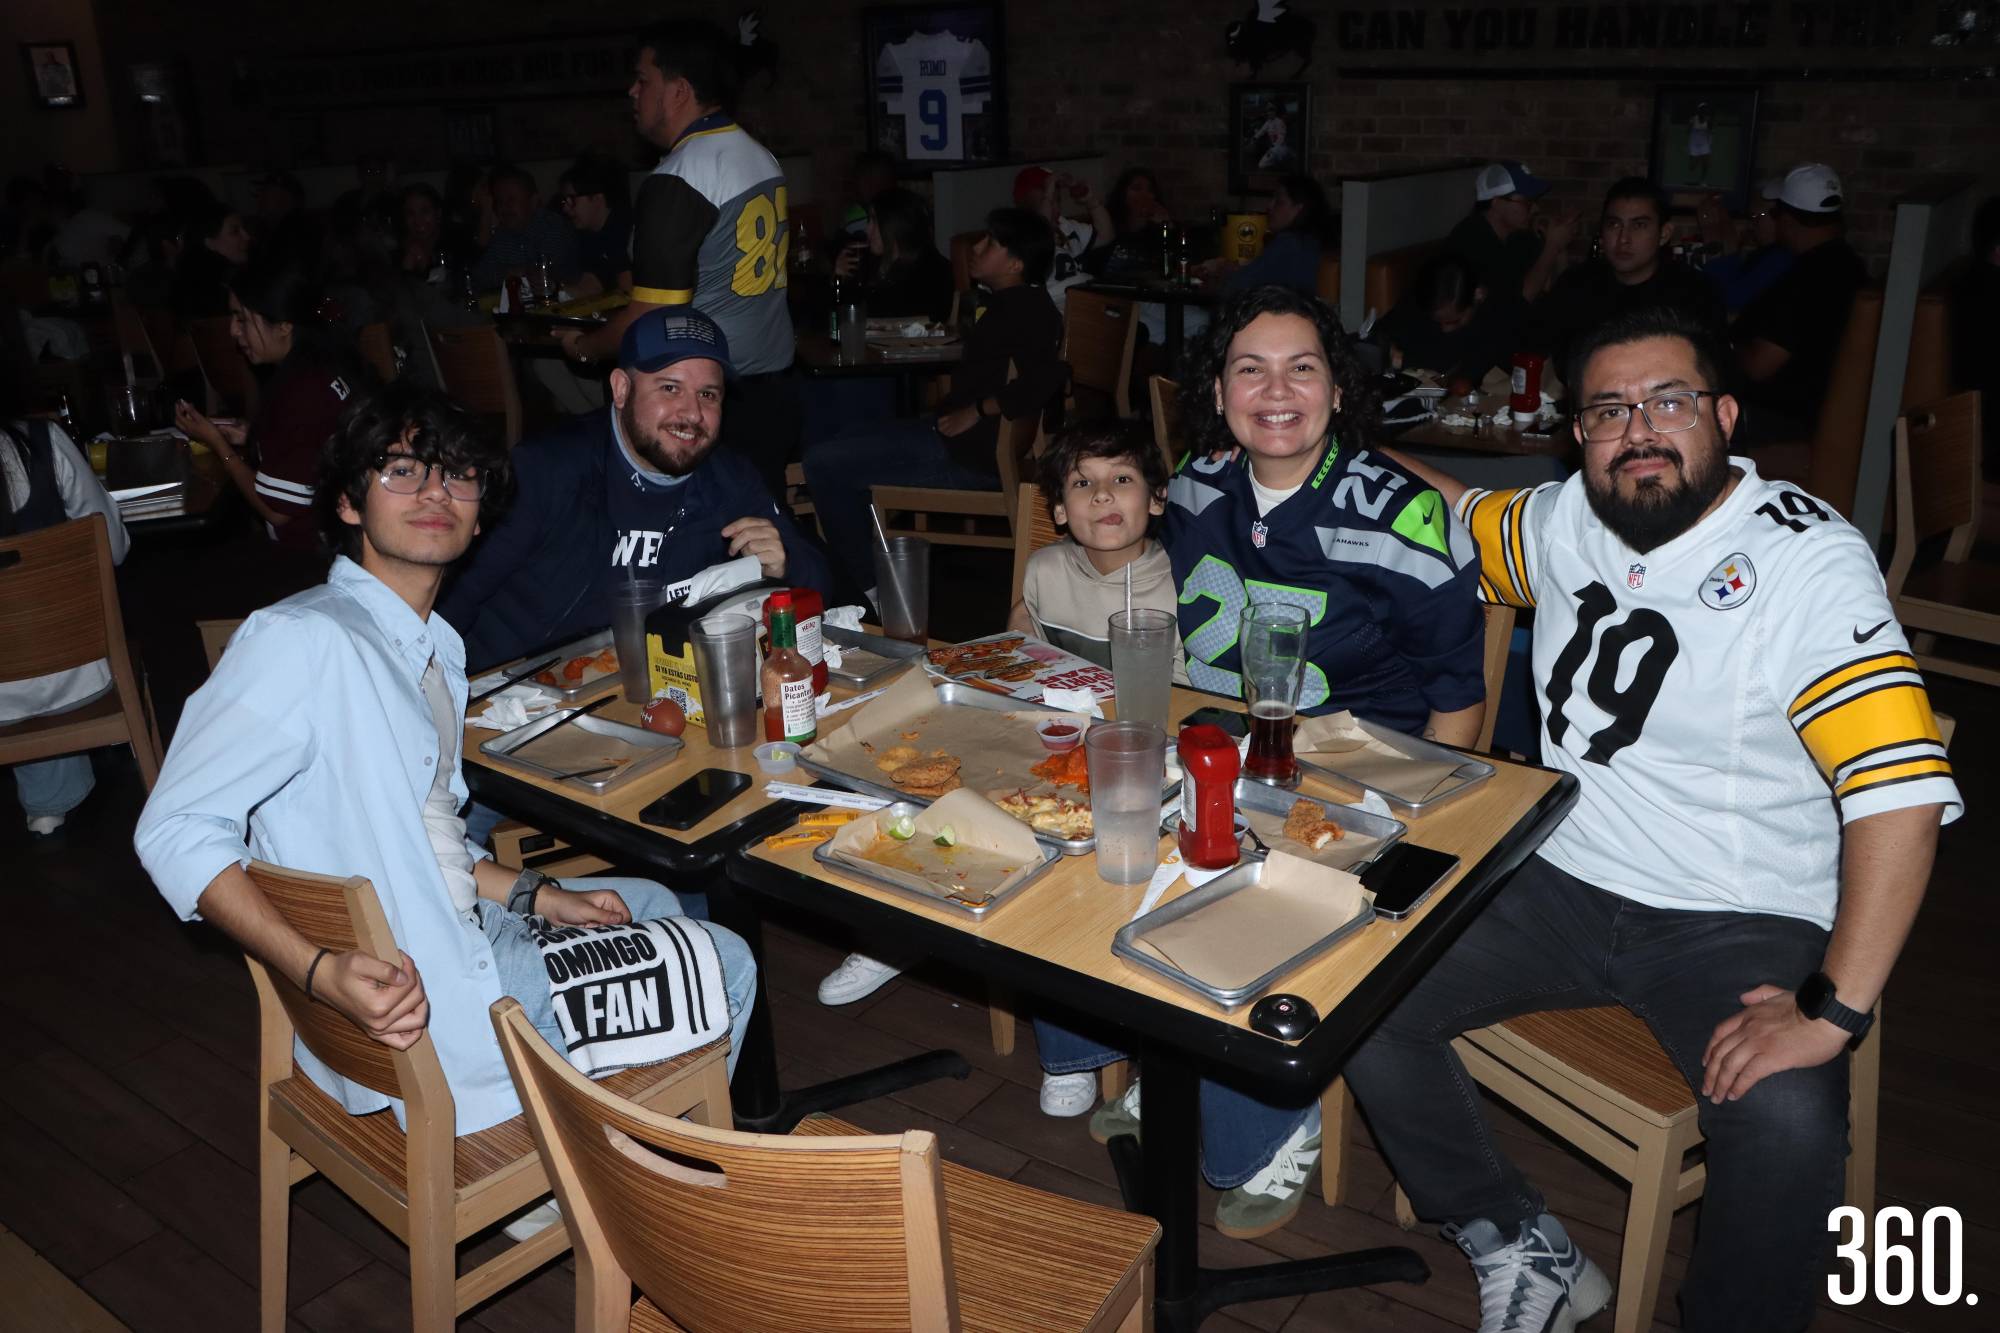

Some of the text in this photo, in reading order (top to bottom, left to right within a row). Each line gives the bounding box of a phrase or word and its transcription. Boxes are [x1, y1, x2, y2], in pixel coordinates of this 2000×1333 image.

[1337, 8, 1427, 50] CAN
[1443, 7, 1537, 50] YOU
[1554, 3, 1770, 48] HANDLE
[919, 59, 947, 77] ROMO
[919, 89, 948, 151] 9
[1332, 450, 1409, 521] 25
[1754, 490, 1831, 533] 19
[1332, 537, 1370, 547] AHAWKS
[1628, 573, 1642, 587] NFL
[1179, 554, 1331, 710] 25
[784, 684, 805, 693] Datos
[1046, 673, 1114, 690] PORTS
[1546, 580, 1680, 767] 19
[544, 932, 658, 984] OMINGO
[584, 977, 661, 1037] FAN
